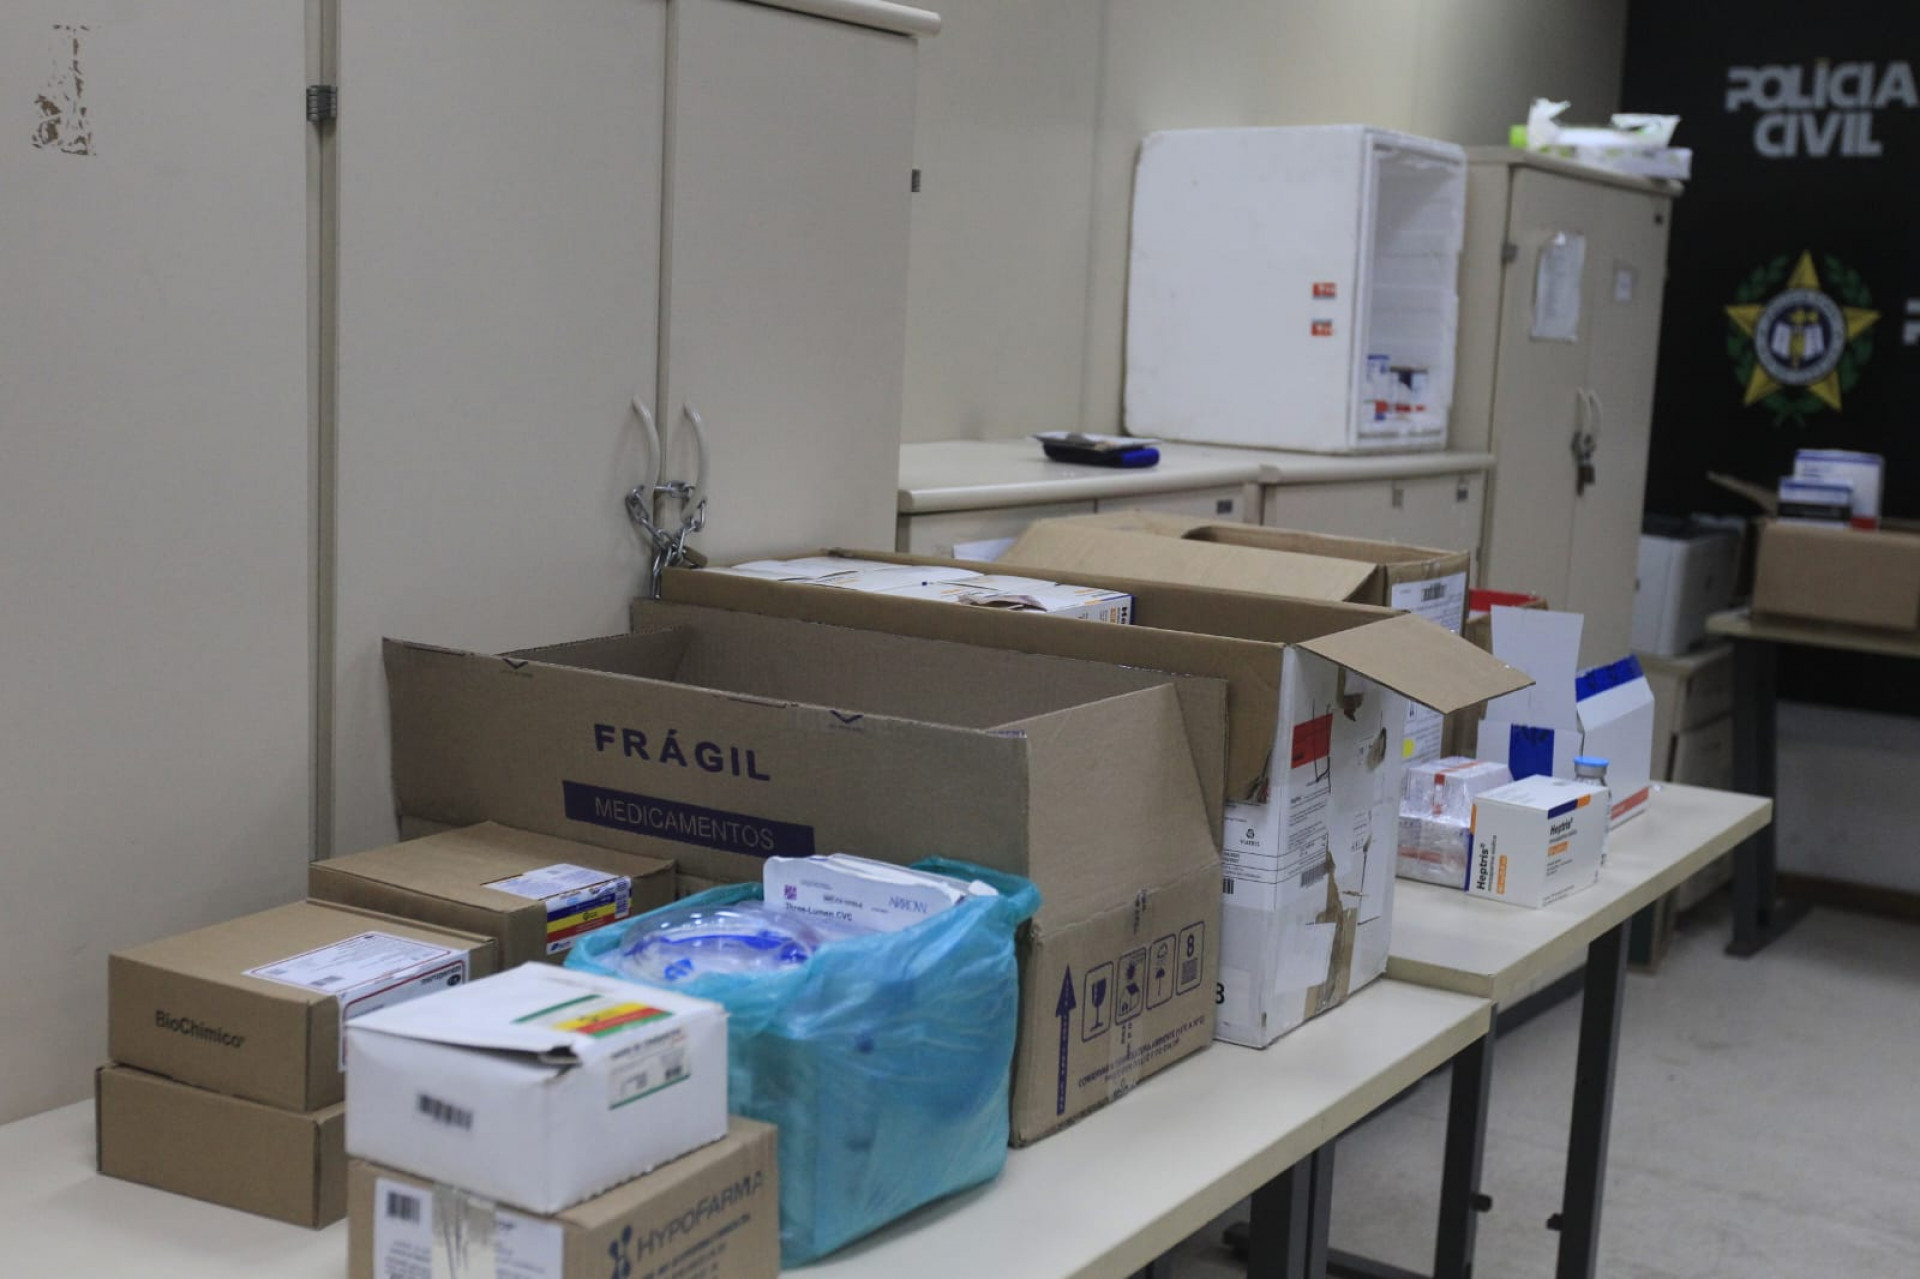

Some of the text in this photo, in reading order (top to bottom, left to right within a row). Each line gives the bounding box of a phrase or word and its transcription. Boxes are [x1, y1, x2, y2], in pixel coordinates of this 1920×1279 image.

[1724, 58, 1919, 112] POLÍCIA
[1753, 111, 1884, 158] CIVIL
[594, 723, 771, 782] FRÁGIL
[595, 796, 775, 851] MEDICAMENTOS
[1186, 933, 1195, 957] 8
[636, 1170, 765, 1261] HYPOFARMA
